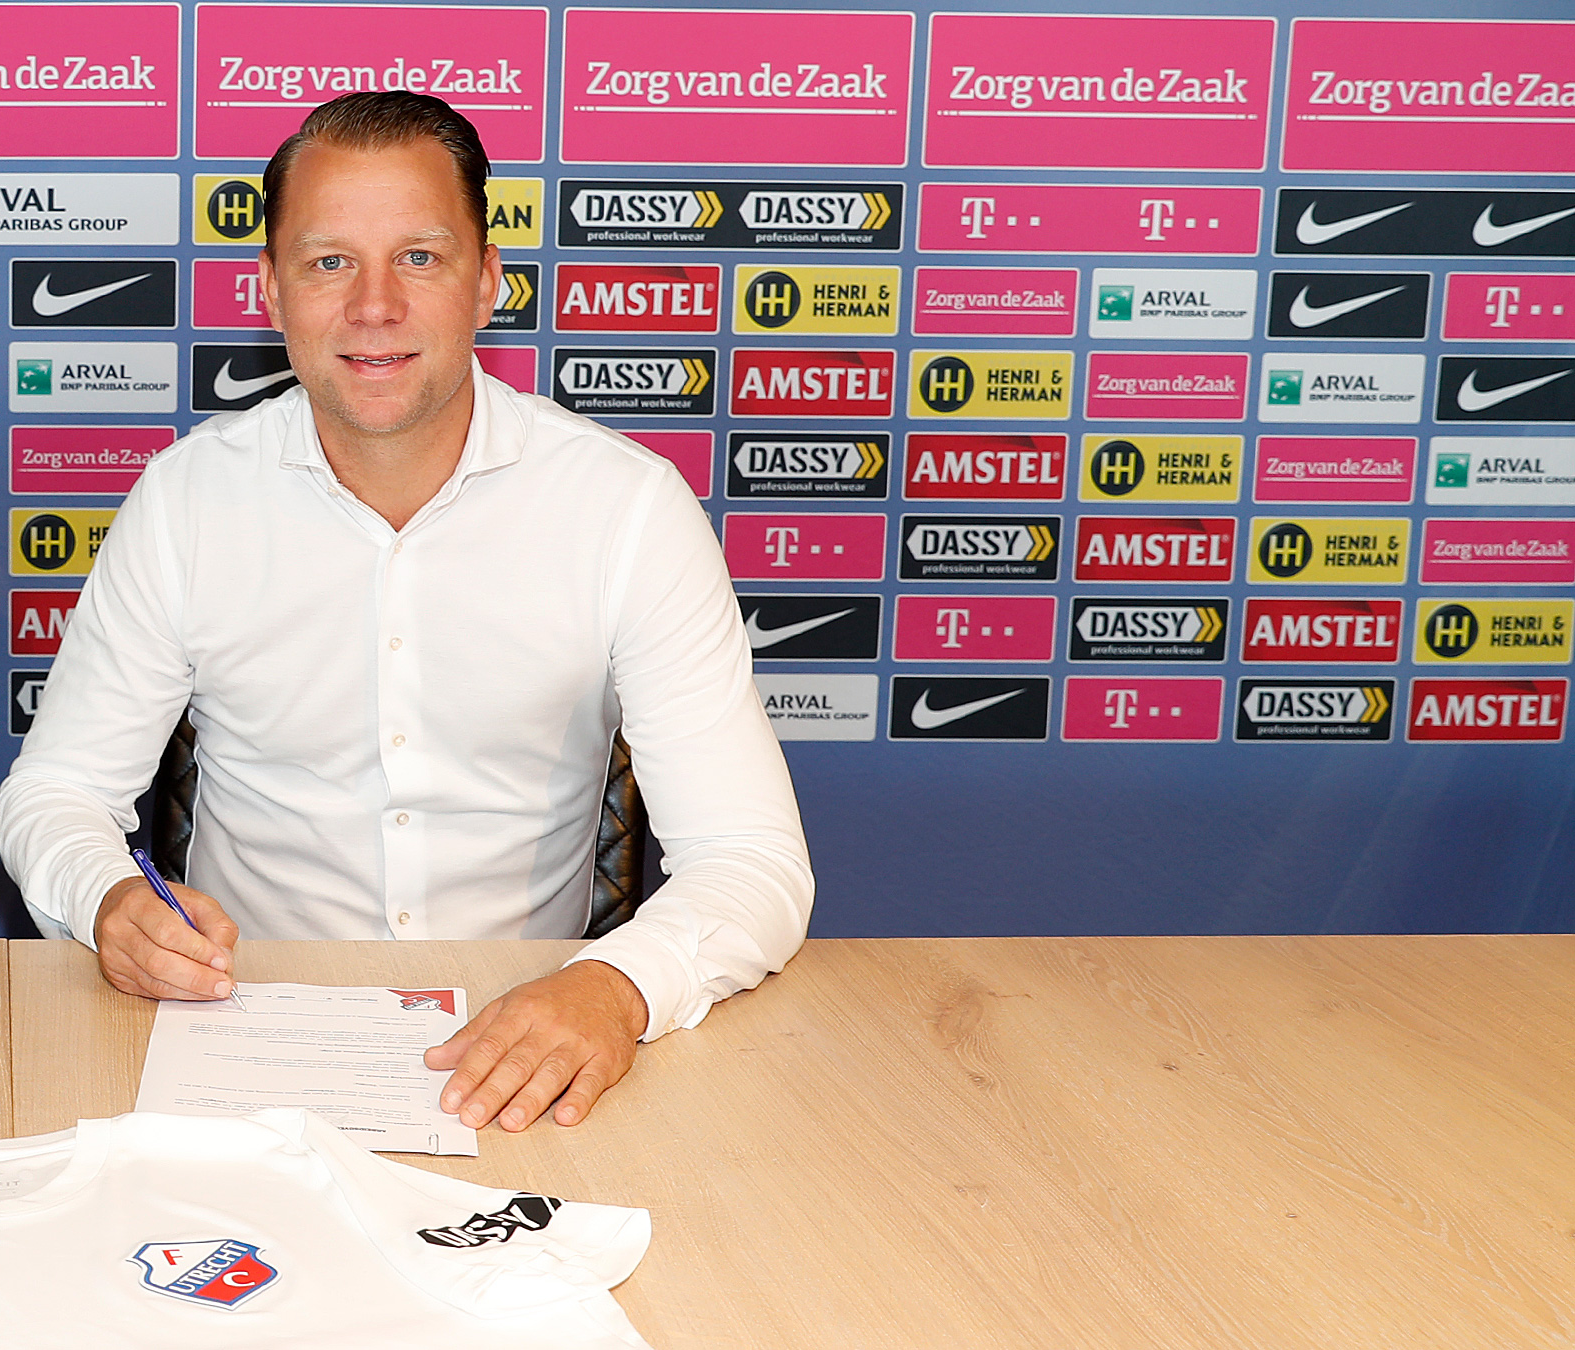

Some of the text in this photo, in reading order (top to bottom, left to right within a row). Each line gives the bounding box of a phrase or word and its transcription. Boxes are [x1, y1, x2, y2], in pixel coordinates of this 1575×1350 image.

[15, 56, 59, 89] de
[63, 56, 155, 89] Zaak
[218, 56, 523, 100] Zorg van de Zaak
[586, 62, 887, 104] Zorg van de Zaak
[950, 66, 1248, 109] Zorg van de Zaak
[1308, 71, 1575, 114] Zorg van de Zaa
[586, 195, 687, 222] DASSY
[754, 197, 856, 224] DASSY
[68, 218, 128, 231] GROUP
[562, 282, 714, 316] AMSTEL
[814, 284, 890, 300] HENRI &
[924, 290, 1065, 312] Zorg van de Zaak
[1141, 291, 1211, 306] ARVAL
[813, 302, 889, 317] HERMAN
[61, 364, 132, 379] ARVAL
[574, 363, 675, 390] DASSY
[738, 367, 888, 400] AMSTEL
[749, 447, 849, 473] DASSY
[911, 451, 1060, 484] AMSTEL
[1158, 453, 1232, 468] HENRI &
[1266, 458, 1403, 479] Zorg van de Zaak
[1478, 458, 1544, 473] ARVAL
[1157, 470, 1231, 485] HERMAN
[921, 530, 1020, 556] DASSY
[1082, 534, 1229, 566] AMSTEL
[1090, 612, 1189, 638] DASSY
[1249, 615, 1395, 647] AMSTEL
[1491, 616, 1565, 631] HENRI &
[1490, 633, 1564, 647] HERMAN
[764, 695, 833, 709] ARVAL
[1257, 692, 1355, 717] DASSY
[1415, 695, 1560, 727] AMSTEL
[162, 1249, 183, 1265] F
[169, 1242, 249, 1294] UTRECHT
[222, 1271, 256, 1287] C
